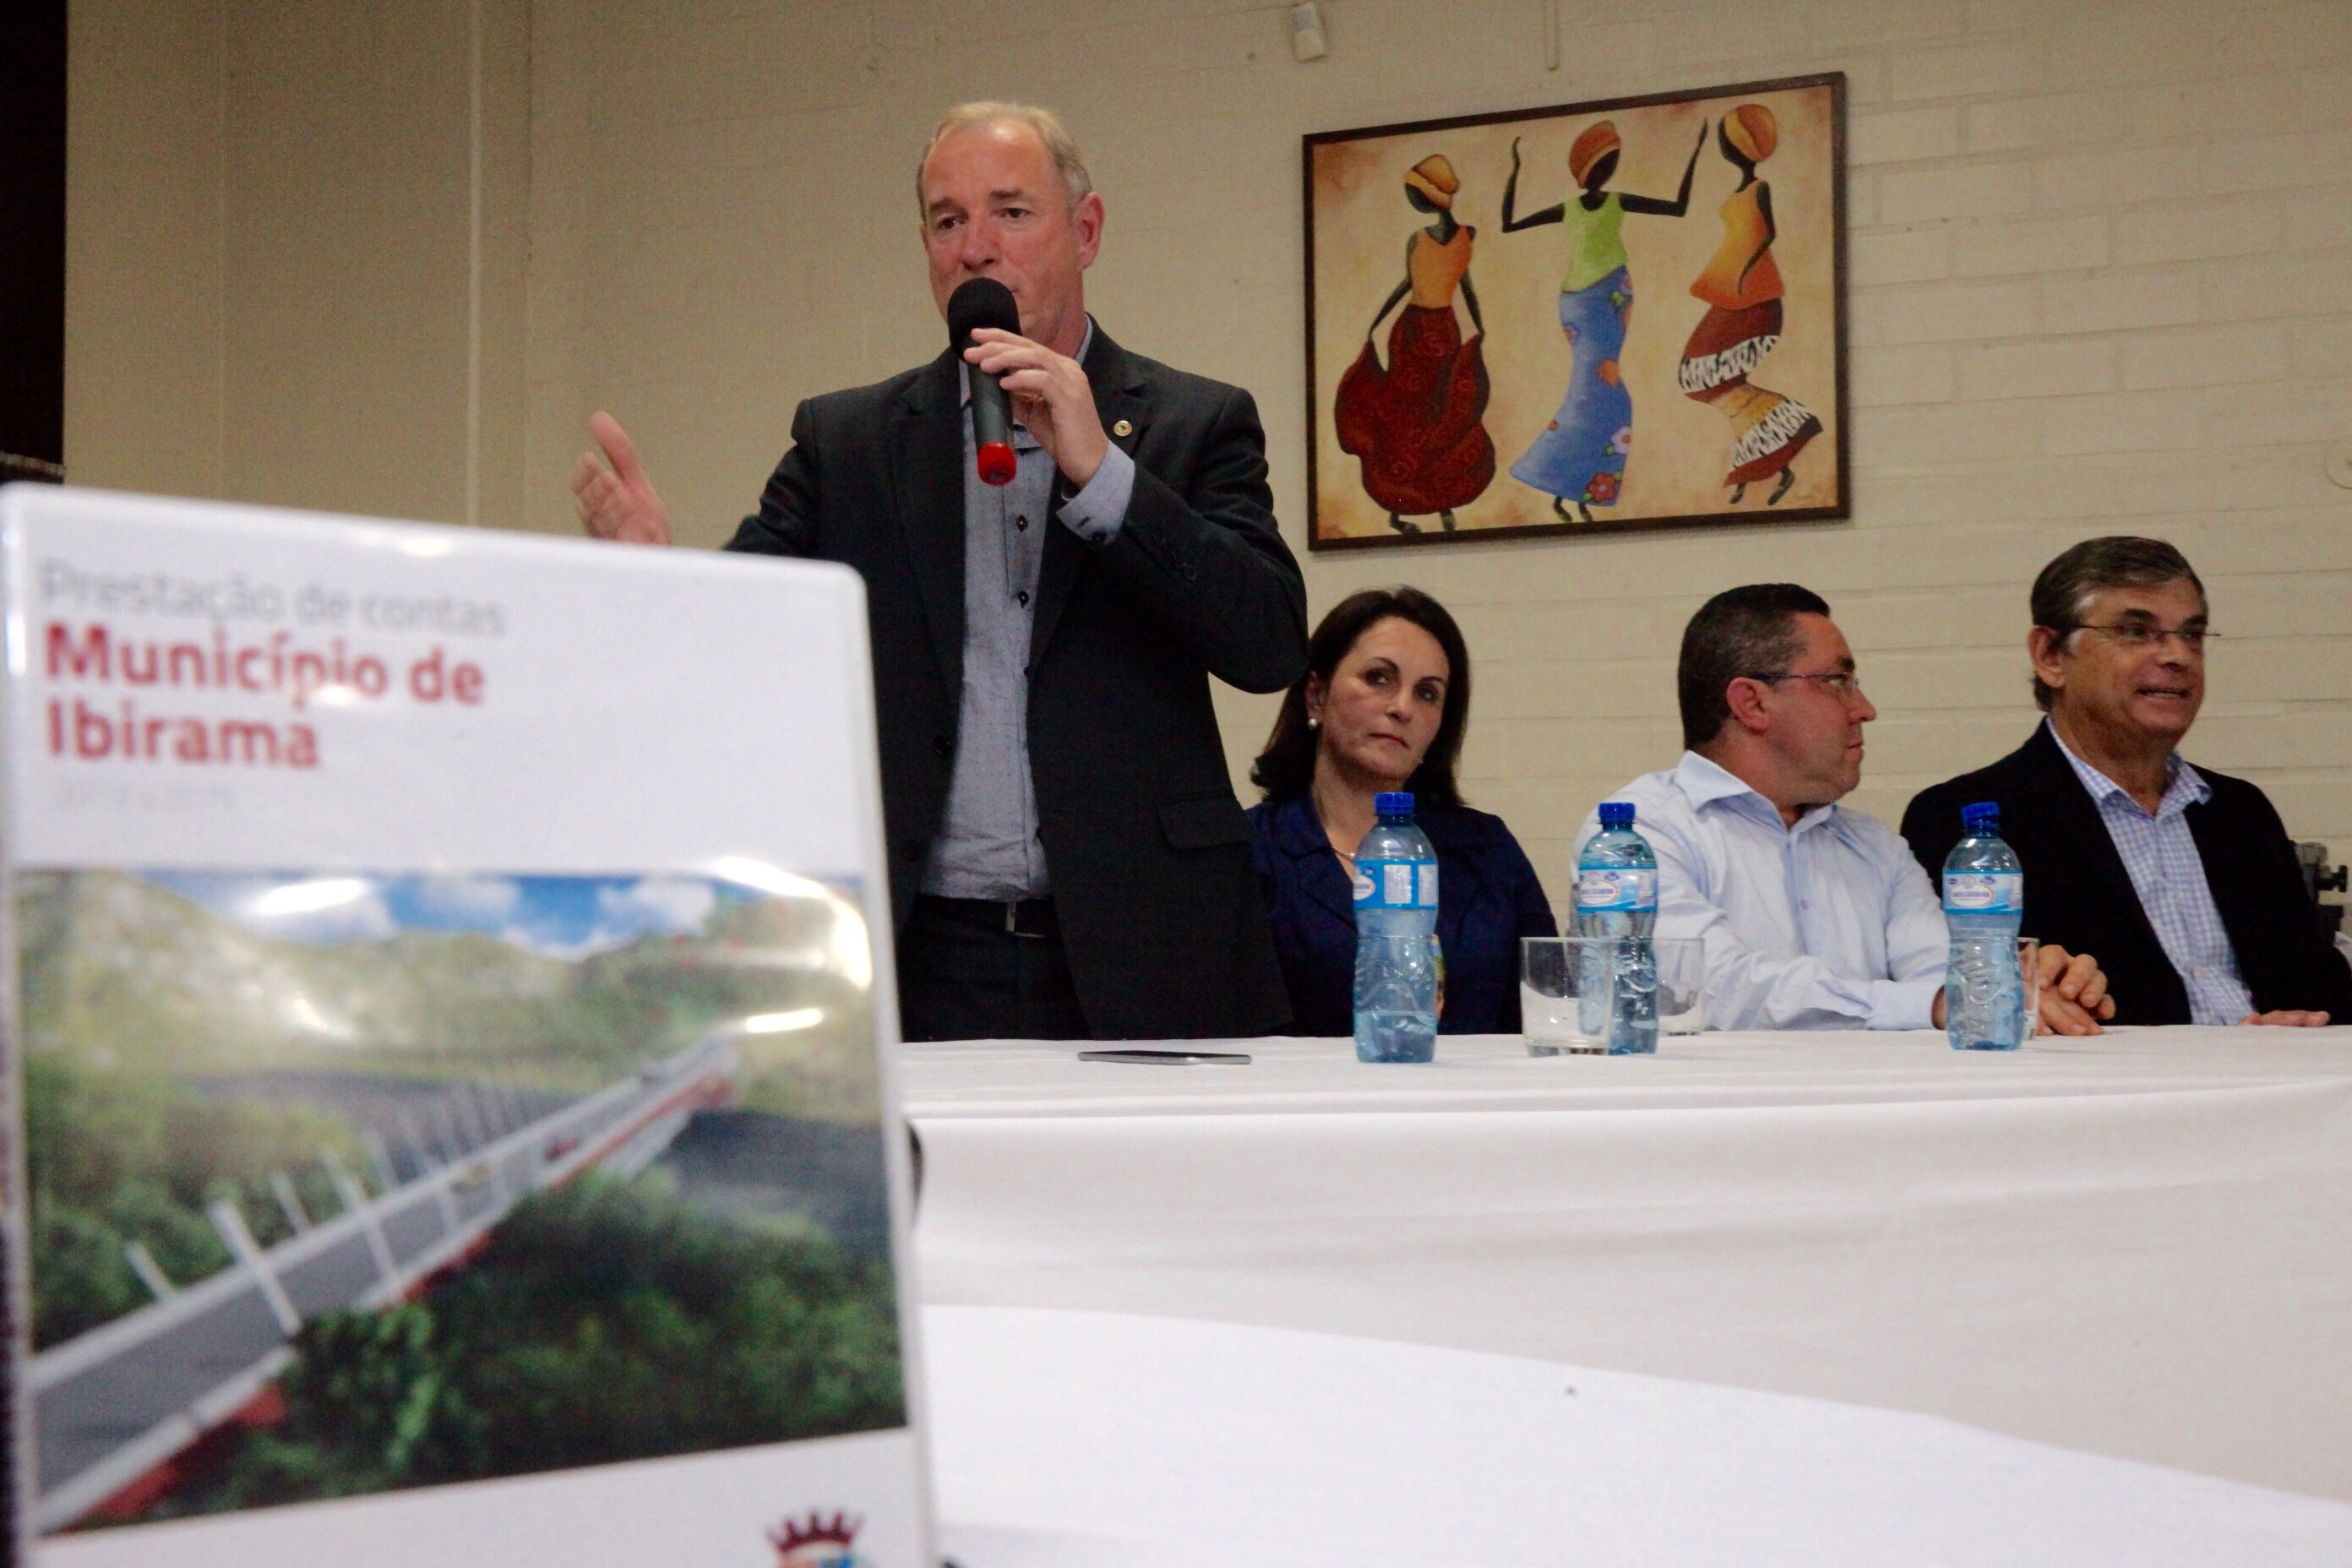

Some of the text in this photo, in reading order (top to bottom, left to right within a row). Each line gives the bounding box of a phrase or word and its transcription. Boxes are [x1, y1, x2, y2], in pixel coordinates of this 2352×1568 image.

[39, 558, 509, 640] Prestação de contas
[44, 619, 488, 712] Município de
[46, 697, 322, 770] Ibirama
